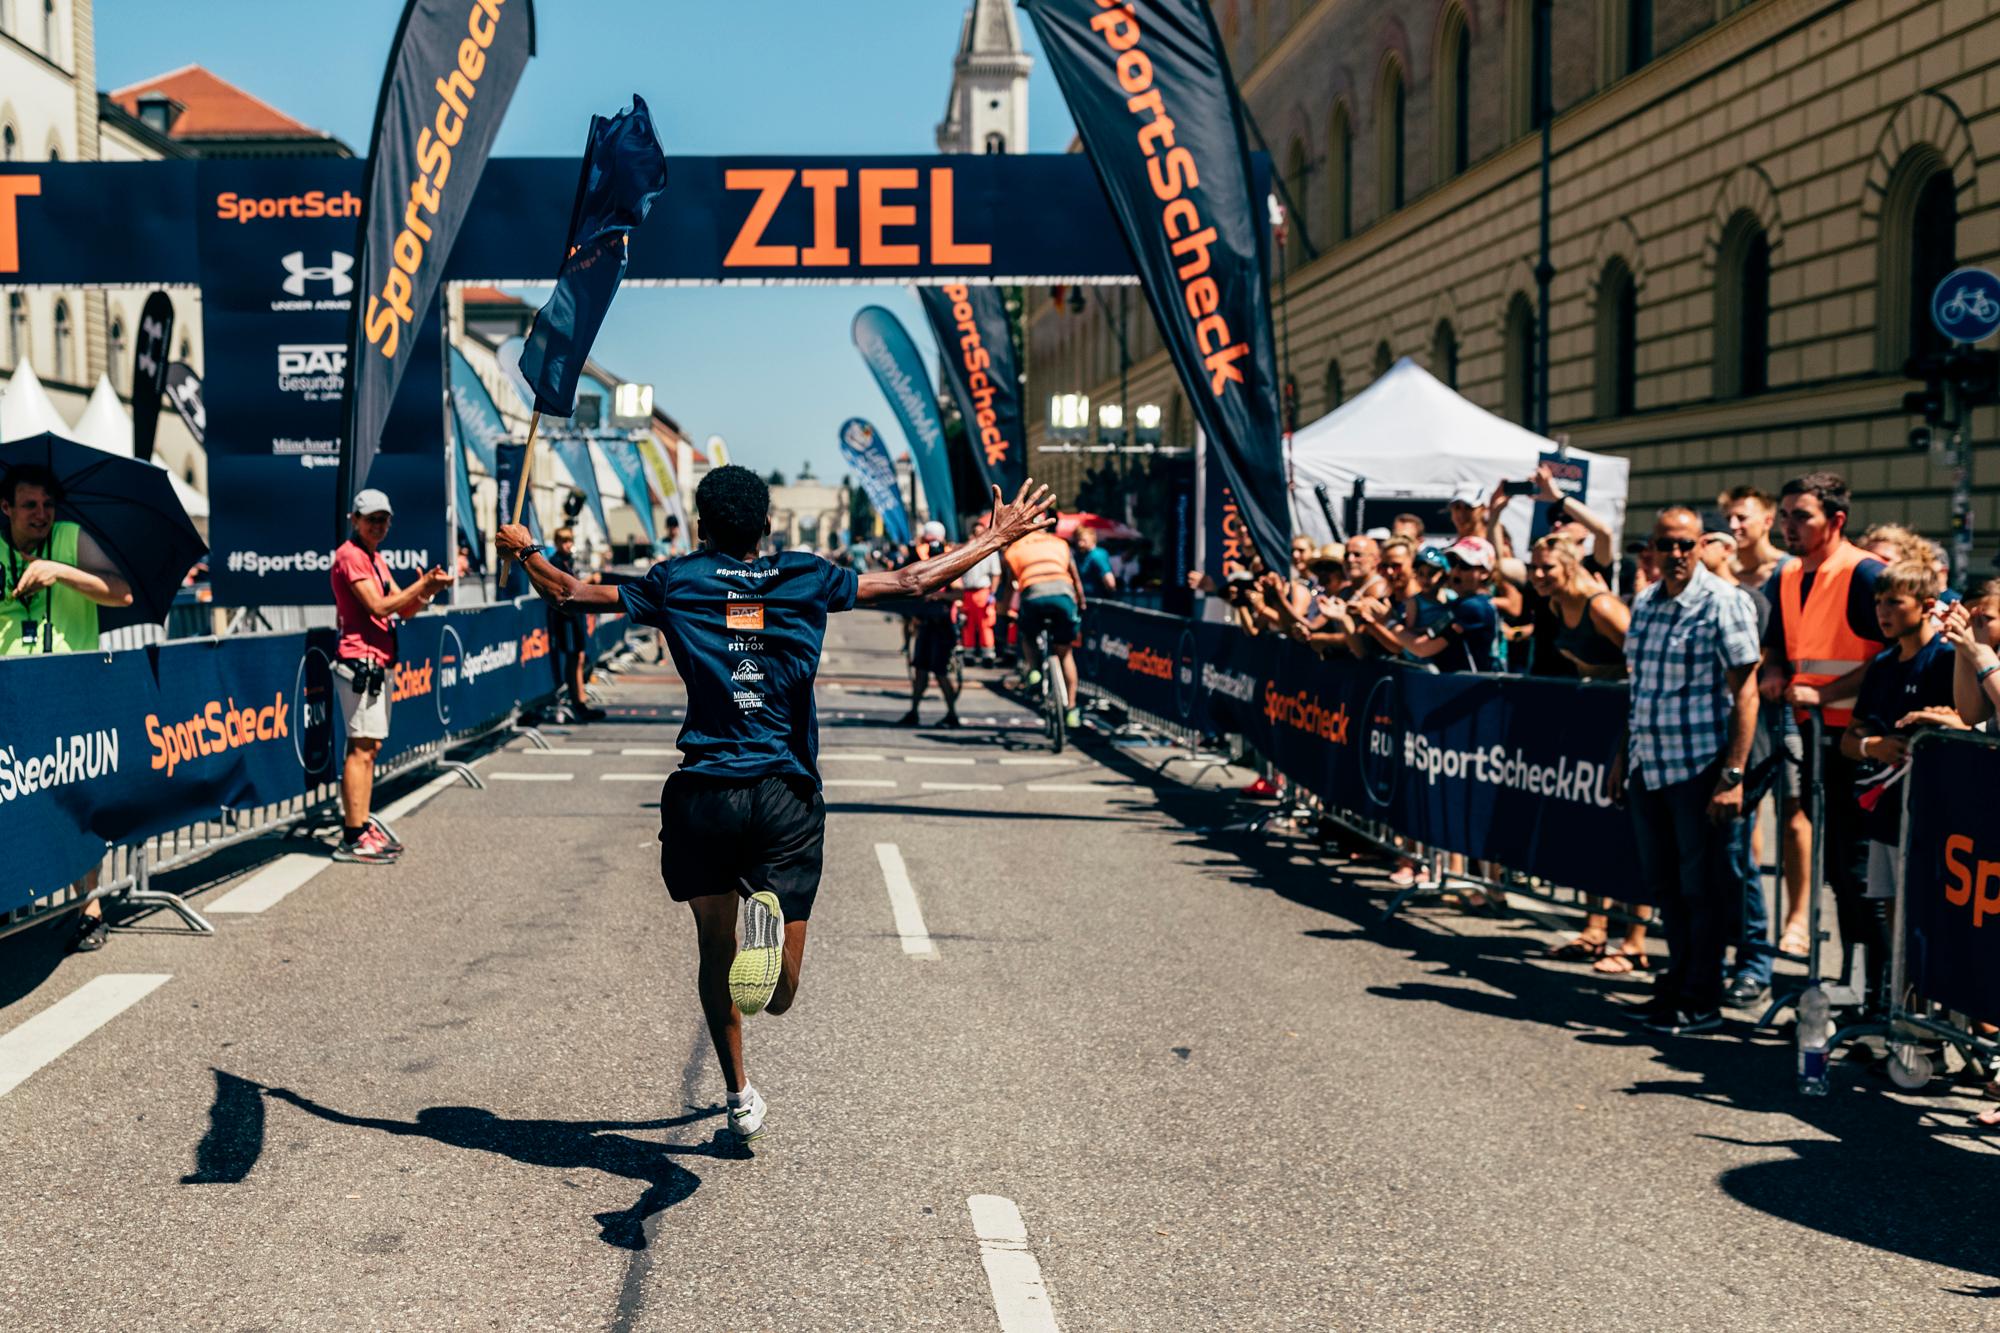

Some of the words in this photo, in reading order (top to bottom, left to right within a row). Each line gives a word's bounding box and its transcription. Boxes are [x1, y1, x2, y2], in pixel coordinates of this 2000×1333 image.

[723, 168, 992, 266] ZIEL
[1090, 0, 1249, 397] portScheck
[271, 300, 313, 311] UNDER
[943, 284, 1009, 466] portScheck
[728, 642, 764, 652] FITFOX
[729, 606, 760, 618] DAK
[1264, 680, 1350, 745] SportScheck
[1404, 731, 1614, 808] #SportScheckRU
[1945, 833, 2000, 928] Sp
